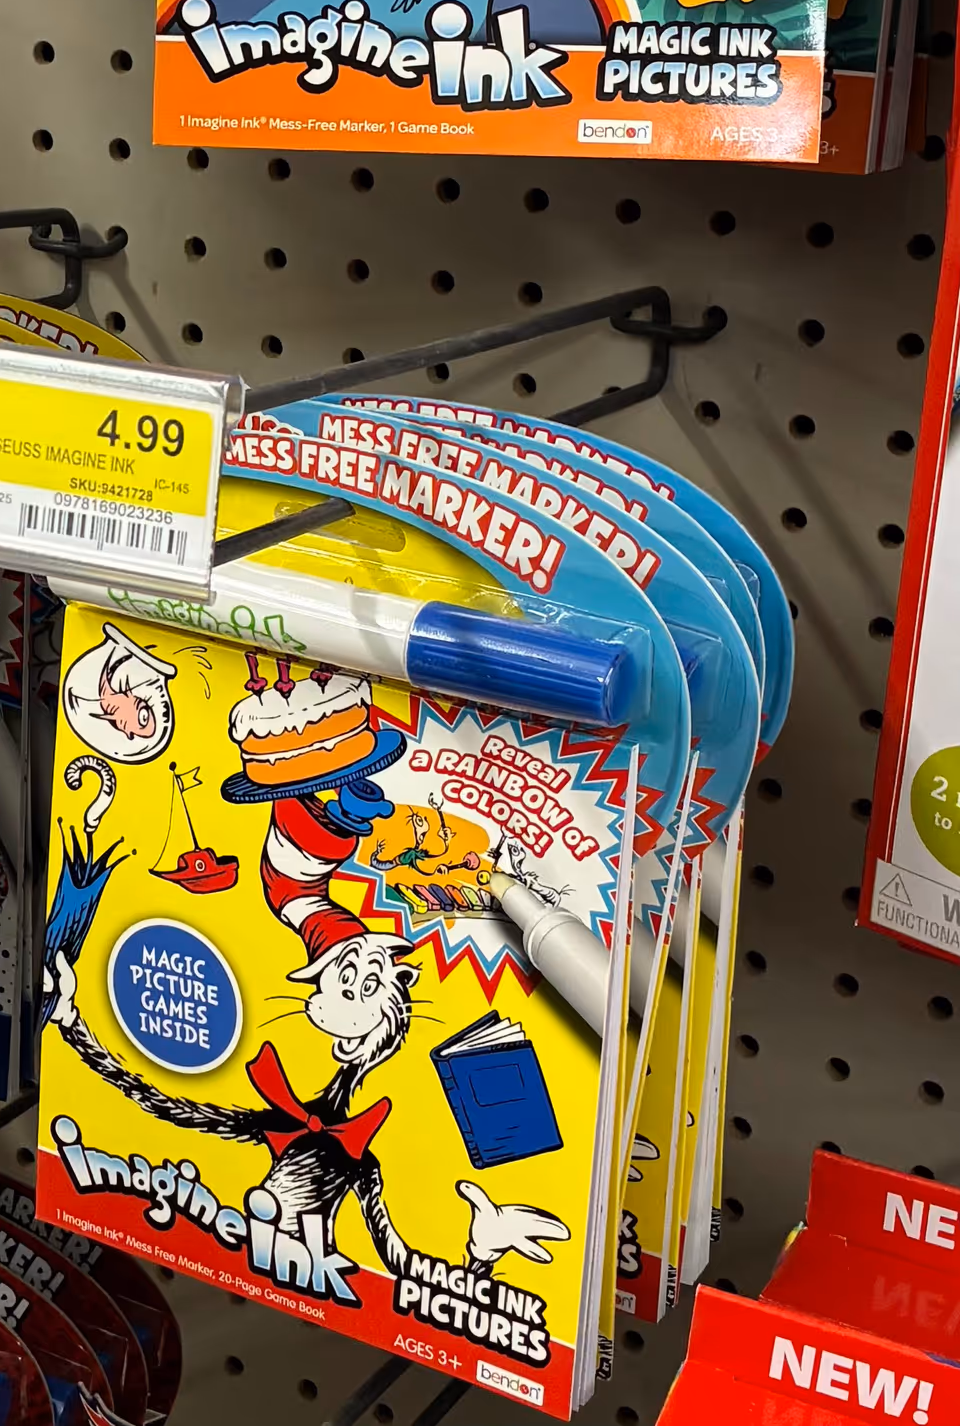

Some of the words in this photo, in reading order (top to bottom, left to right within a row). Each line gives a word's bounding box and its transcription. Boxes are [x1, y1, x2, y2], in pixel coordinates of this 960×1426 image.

[429, 3, 567, 104] ink
[612, 25, 711, 57] MAGIC
[718, 27, 773, 59] INK
[603, 59, 779, 99] PICTURES
[187, 116, 238, 130] Imagine
[269, 118, 338, 131] Mess-Free
[339, 120, 387, 133] Marker,
[397, 122, 438, 134] Game
[440, 122, 474, 135] Book
[582, 122, 650, 140] bendon
[710, 126, 764, 143] AGES
[97, 409, 185, 457] 4.99
[45, 446, 106, 471] IMAGINE
[110, 456, 136, 475] INK
[69, 478, 153, 502] SKU:9421728
[154, 479, 190, 494] IC-145
[54, 492, 173, 524] 0978169023236
[225, 436, 294, 471] MESS
[300, 442, 379, 493] FREE
[381, 463, 562, 589] MARKER!
[481, 735, 570, 792] Reveal
[436, 749, 573, 831] RAINBOW
[931, 776, 948, 802] 2
[441, 779, 553, 857] COLORS!
[934, 812, 952, 830] to
[142, 945, 205, 978] MAGIC
[130, 965, 218, 1006] PICTURE
[141, 992, 208, 1024] GAMES
[139, 1013, 210, 1049] INSIDE
[54, 1117, 247, 1243] imagine
[246, 1189, 358, 1301] ink
[62, 1213, 102, 1235] Imagine
[126, 1236, 152, 1254] Mess
[154, 1246, 175, 1263] Free
[177, 1254, 216, 1280] Marker,
[219, 1271, 262, 1297] 20-Page
[264, 1288, 297, 1309] Game
[298, 1300, 326, 1320] Book
[410, 1257, 491, 1304] MAGIC
[497, 1285, 544, 1324] INK
[398, 1282, 548, 1361] PICTURES
[394, 1334, 434, 1361] AGES
[437, 1349, 463, 1369] 3+
[480, 1364, 541, 1397] bendon
[769, 1336, 934, 1425] NEW!
